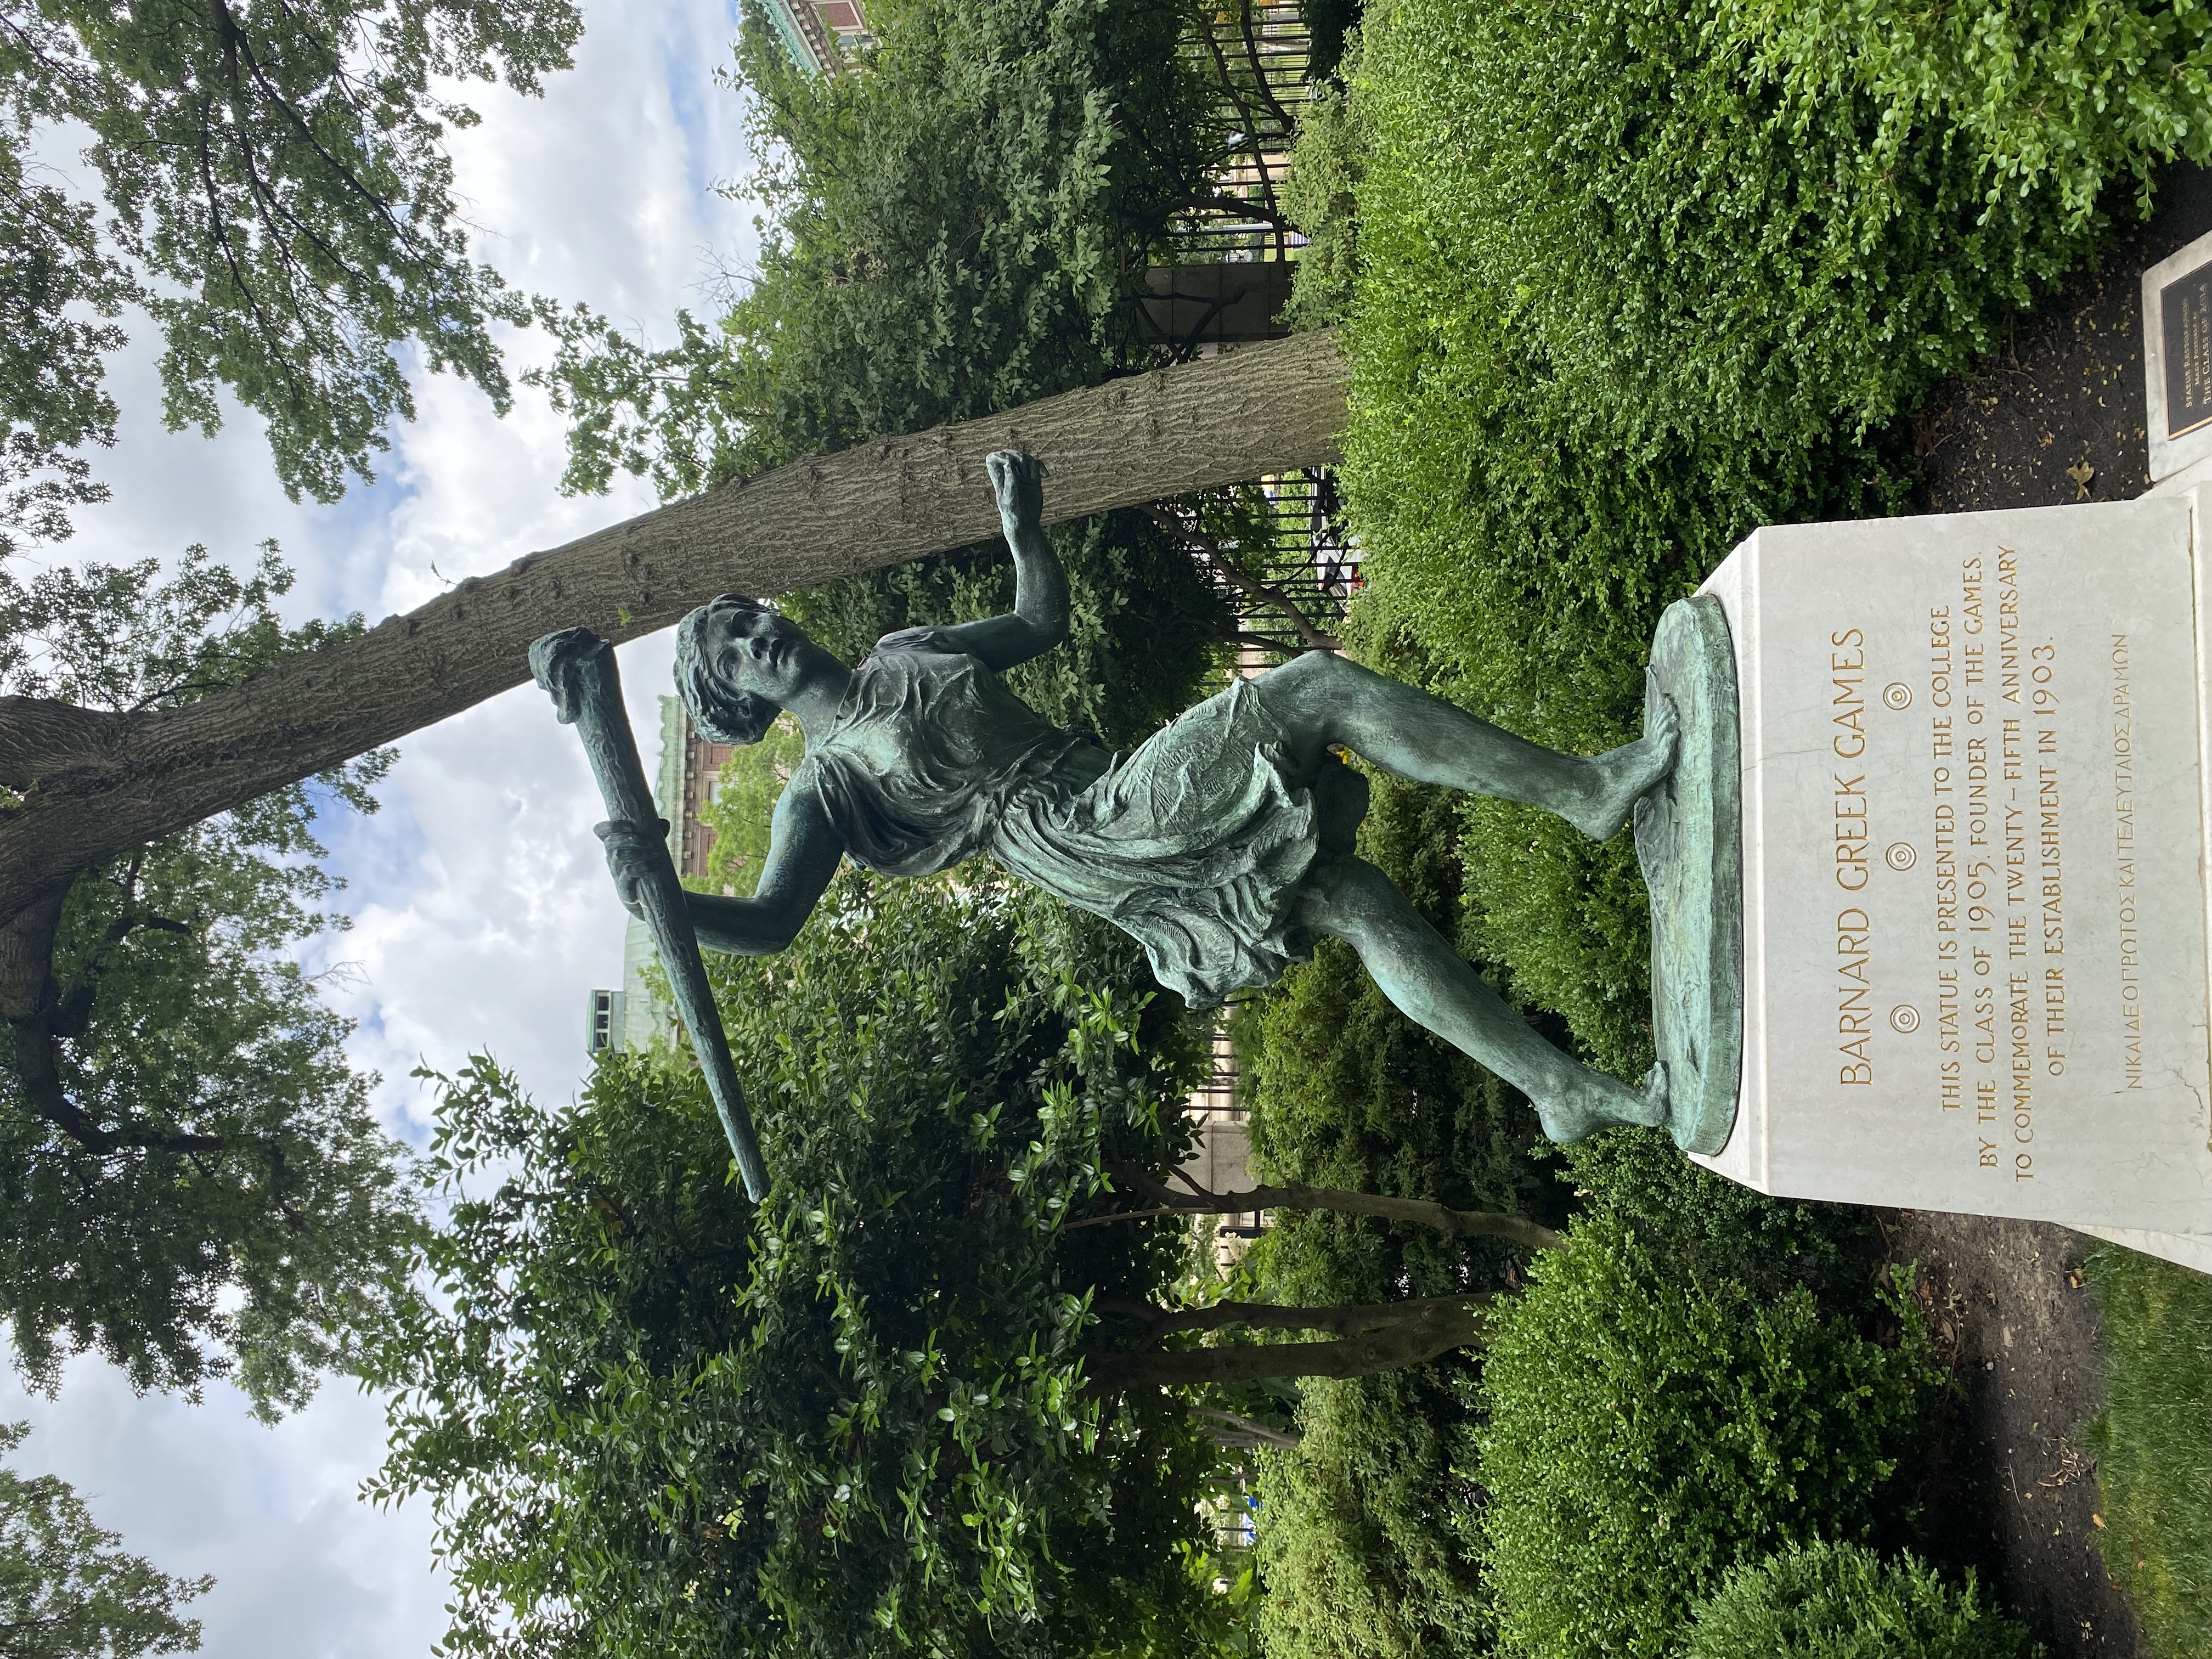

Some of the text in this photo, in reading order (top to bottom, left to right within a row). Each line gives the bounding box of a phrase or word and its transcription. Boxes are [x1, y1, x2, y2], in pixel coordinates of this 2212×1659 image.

[2199, 283, 2212, 404] THE CLASS OF 2014
[2185, 370, 2193, 408] STATUE
[1997, 544, 2021, 705] ANNIVERSARY
[1965, 643, 1984, 687] THE
[1966, 695, 1985, 725] OF
[2038, 730, 2058, 754] IN
[1967, 737, 1989, 847] FOUNDER
[1831, 628, 1874, 1086] BARNARD GREEK GAMES
[1930, 605, 1961, 1112] THIS STATUE IS PRESENTED TO THE COLLEGE
[2039, 764, 2064, 955] ESTABLISHMENT
[1973, 946, 1993, 976] OF
[2008, 916, 2028, 960] THE
[2045, 967, 2066, 1037] THEIR
[1974, 987, 1995, 1064] CLASS
[2009, 970, 2034, 1143] COMMEMORATE
[2047, 1046, 2067, 1076] OF
[1977, 1079, 1997, 1125] THE
[1978, 1136, 1999, 1167] BY
[2015, 1153, 2035, 1183] TO
